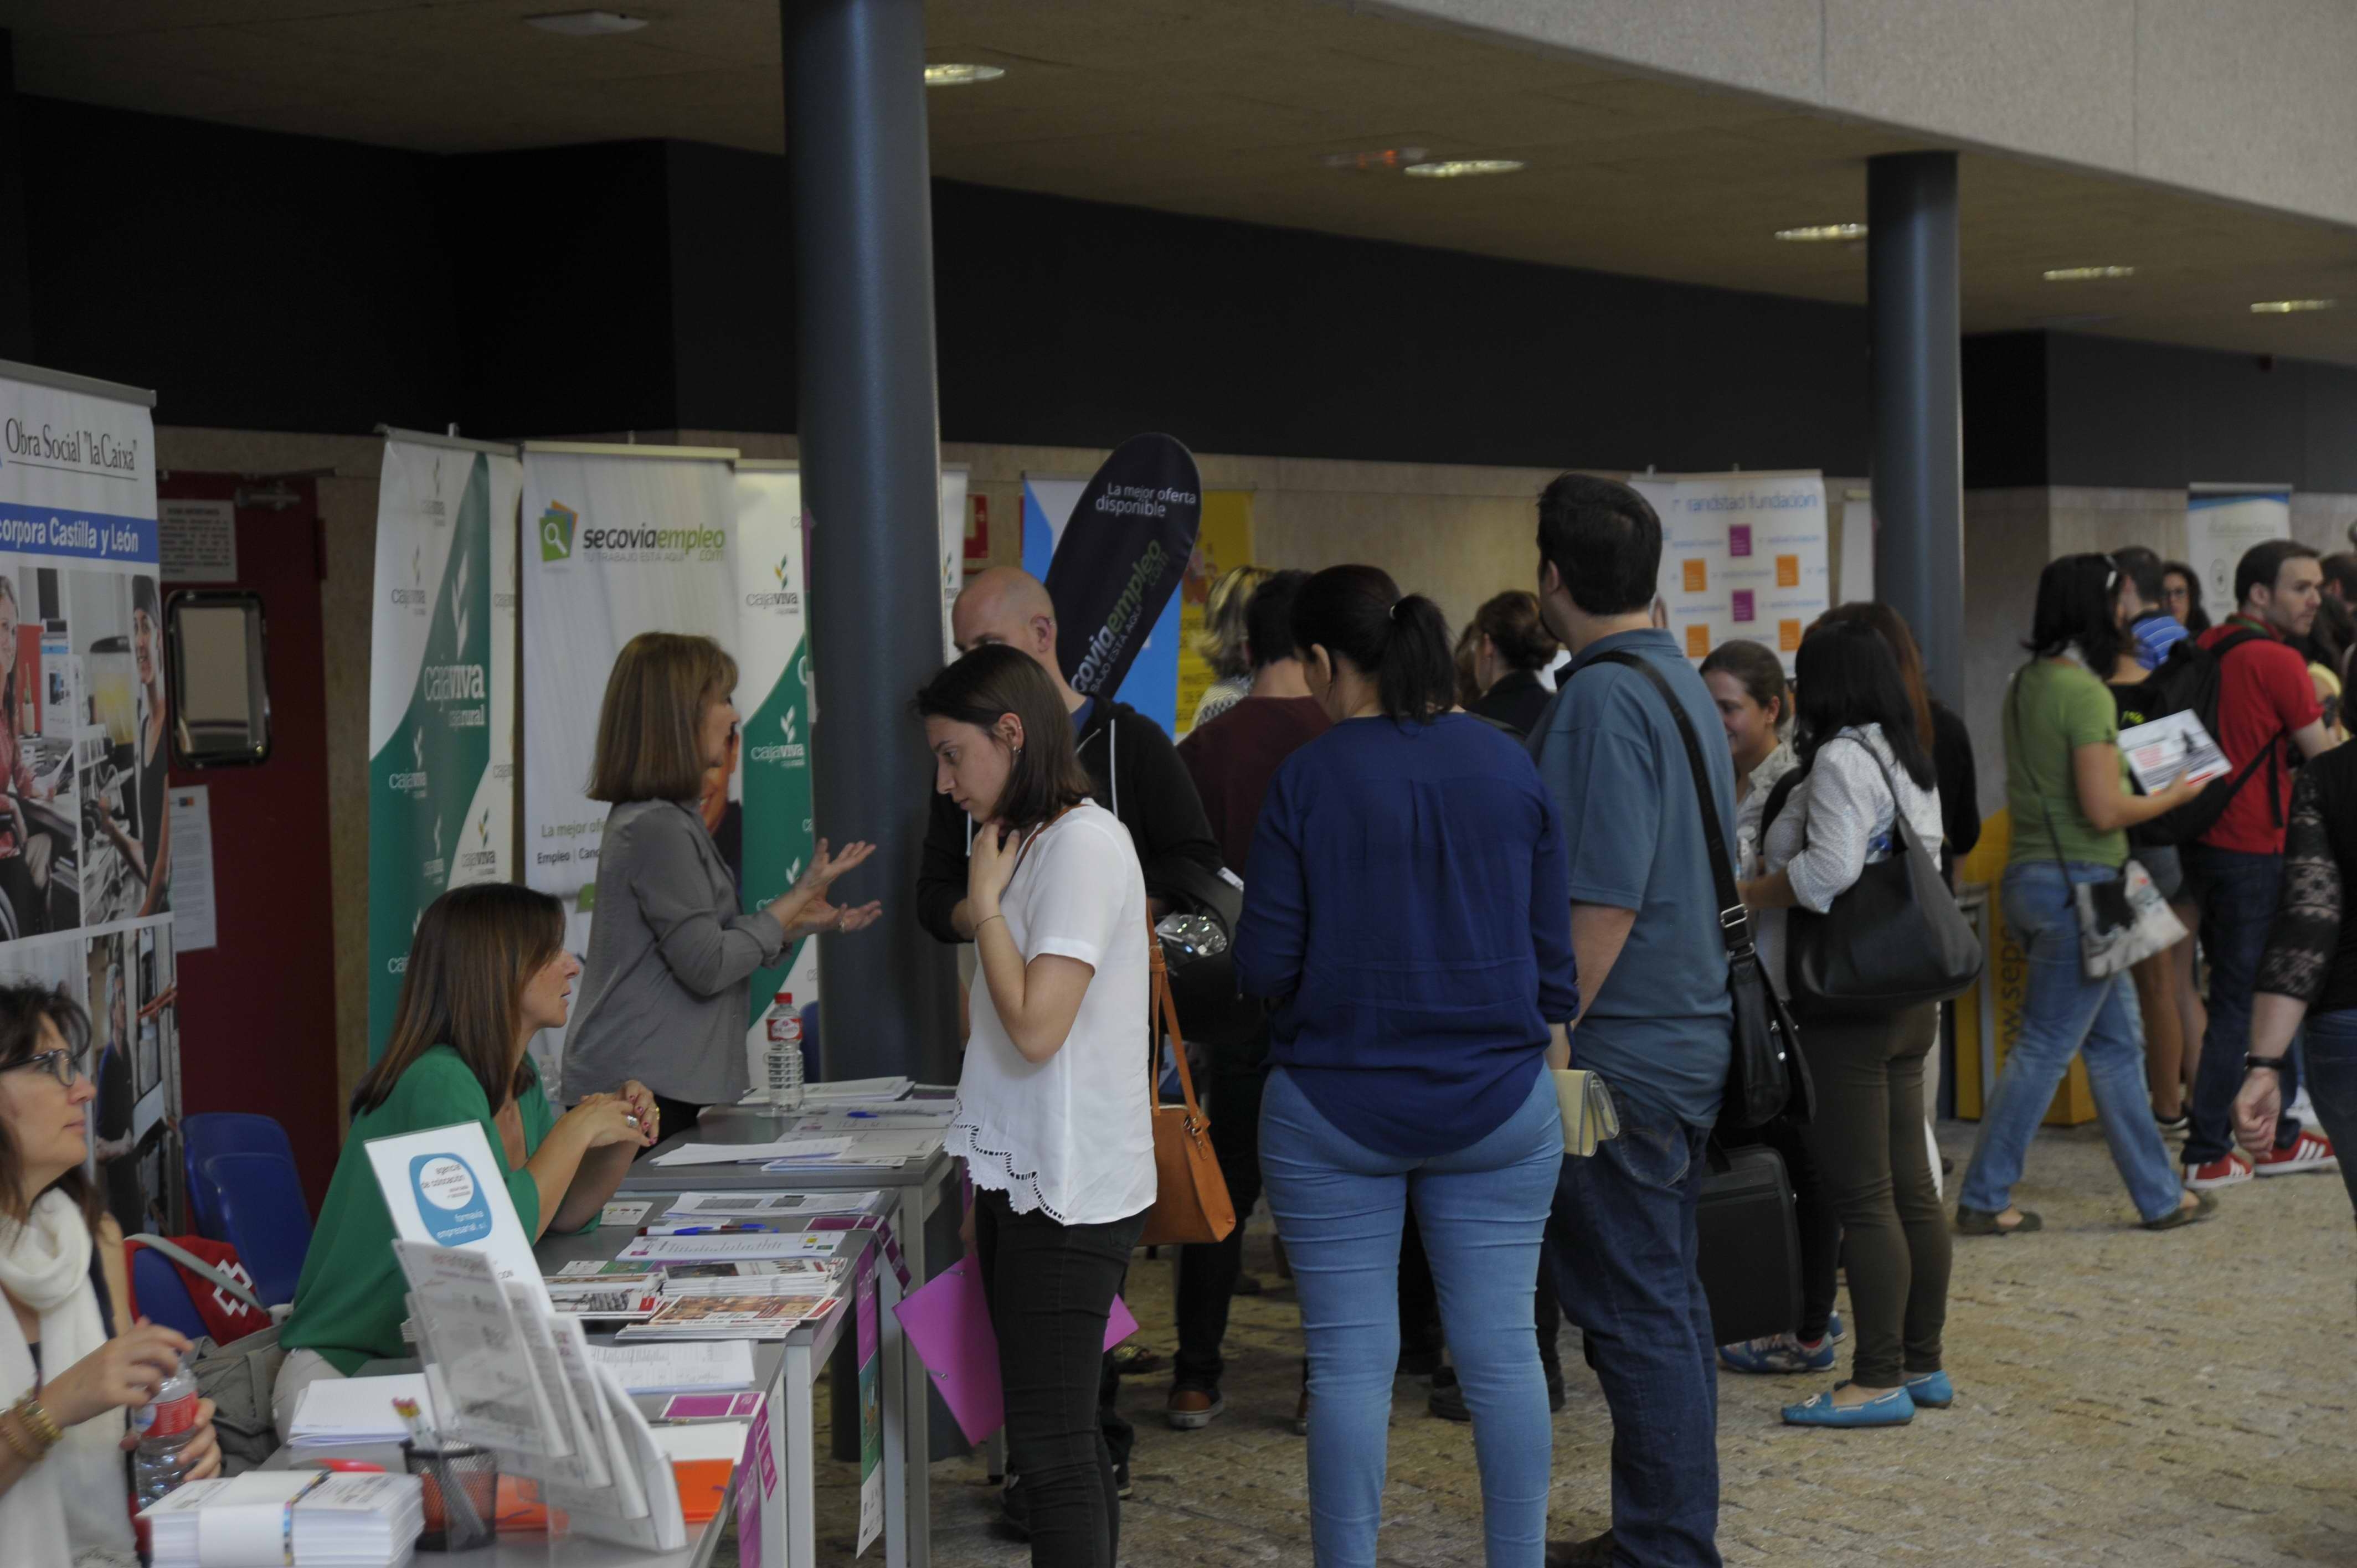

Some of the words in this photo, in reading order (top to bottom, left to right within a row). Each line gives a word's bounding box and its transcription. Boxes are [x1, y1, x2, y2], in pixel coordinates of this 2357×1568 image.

[6, 418, 41, 456] Obra
[43, 424, 81, 462] Social
[1108, 482, 1121, 496] La
[1124, 484, 1155, 501] mejor
[1157, 487, 1197, 504] oferta
[1095, 495, 1166, 518] disponible
[0, 518, 46, 549] orpora
[50, 517, 97, 549] Castilla
[101, 528, 109, 556] y
[111, 523, 138, 553] León
[541, 823, 554, 838] La
[557, 820, 588, 838] mejor
[537, 850, 570, 865] Empleo
